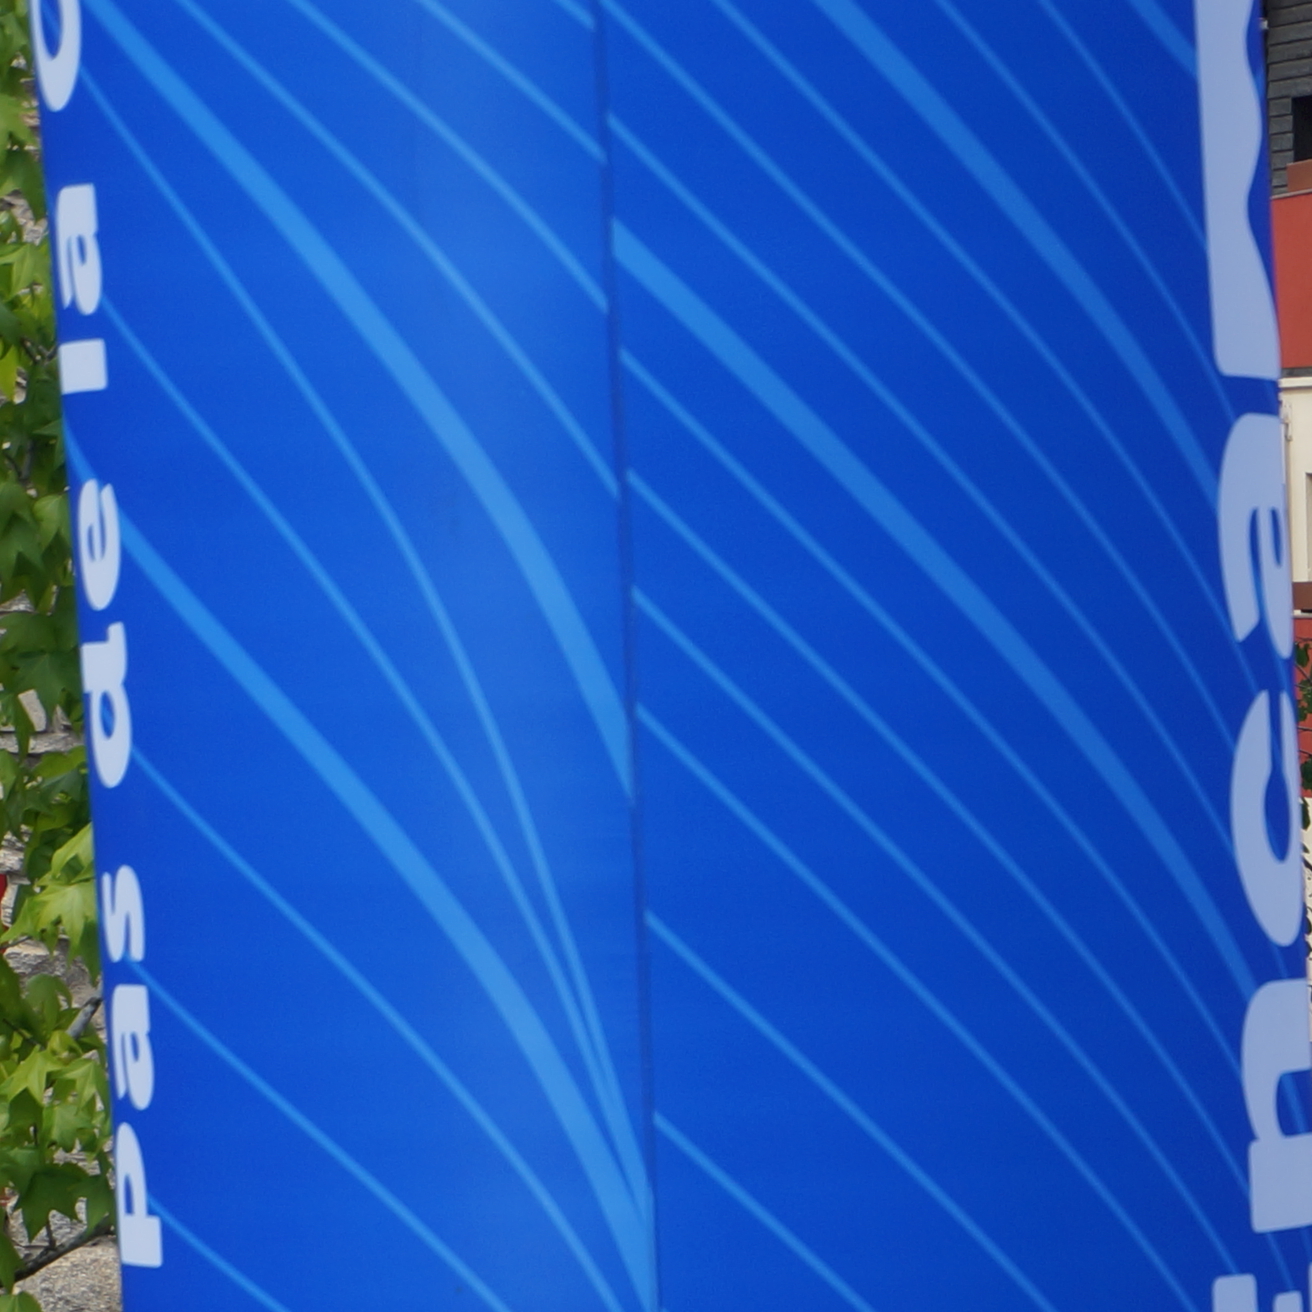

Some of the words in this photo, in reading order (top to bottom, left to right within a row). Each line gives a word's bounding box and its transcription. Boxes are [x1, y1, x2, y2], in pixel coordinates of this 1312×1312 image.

[56, 183, 108, 394] la
[79, 479, 133, 788] de
[101, 864, 163, 1268] Pas
